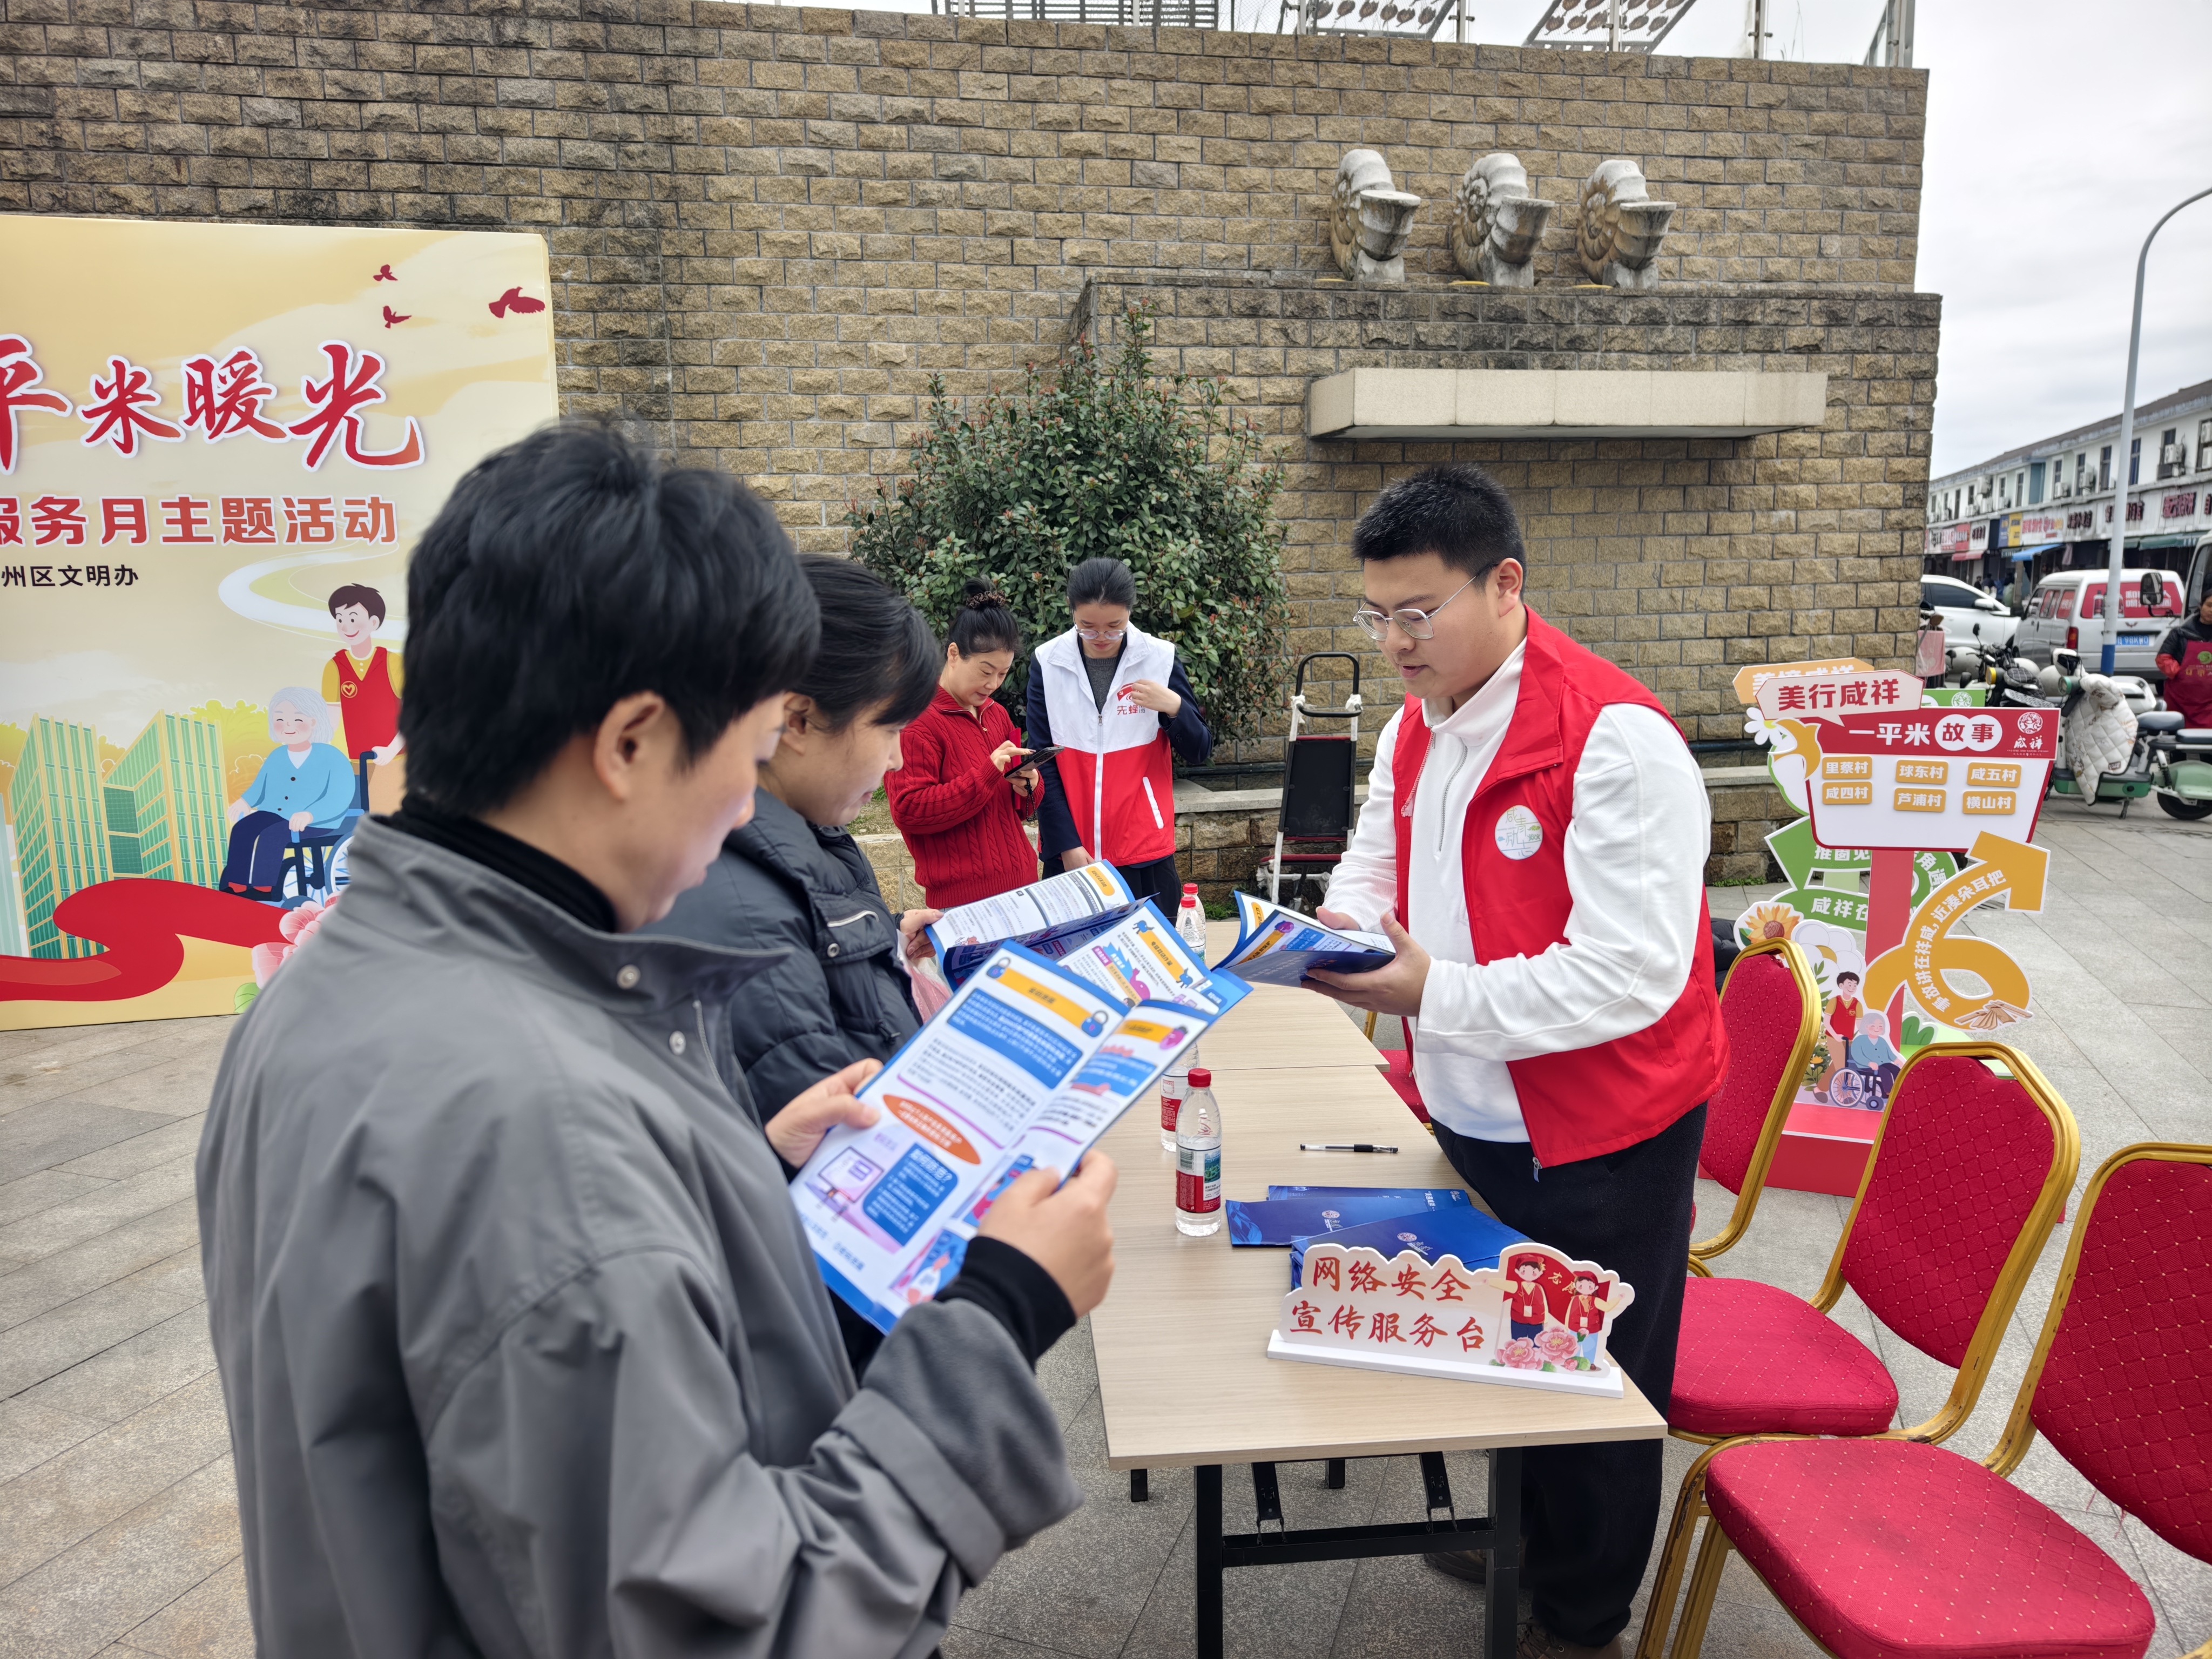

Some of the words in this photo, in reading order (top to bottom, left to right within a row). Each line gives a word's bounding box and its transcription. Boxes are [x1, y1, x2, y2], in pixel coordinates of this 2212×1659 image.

[2, 564, 139, 588] 州区文明办
[1778, 678, 1900, 711] 美行咸祥
[1849, 723, 1994, 746] 一平米故事
[2014, 735, 2043, 750] 咸祥
[1826, 761, 1868, 774] 里蔡村
[1900, 765, 1944, 779] 球东村
[1971, 768, 2017, 782] 咸五村
[1826, 787, 1868, 799] 咸四村
[1898, 793, 1942, 807] 芦浦村
[1966, 796, 2012, 809] 横山村
[1811, 897, 1868, 921] 咸祥在
[1313, 1256, 1472, 1301] 网络安全
[1289, 1300, 1485, 1352] 宣传服务台
